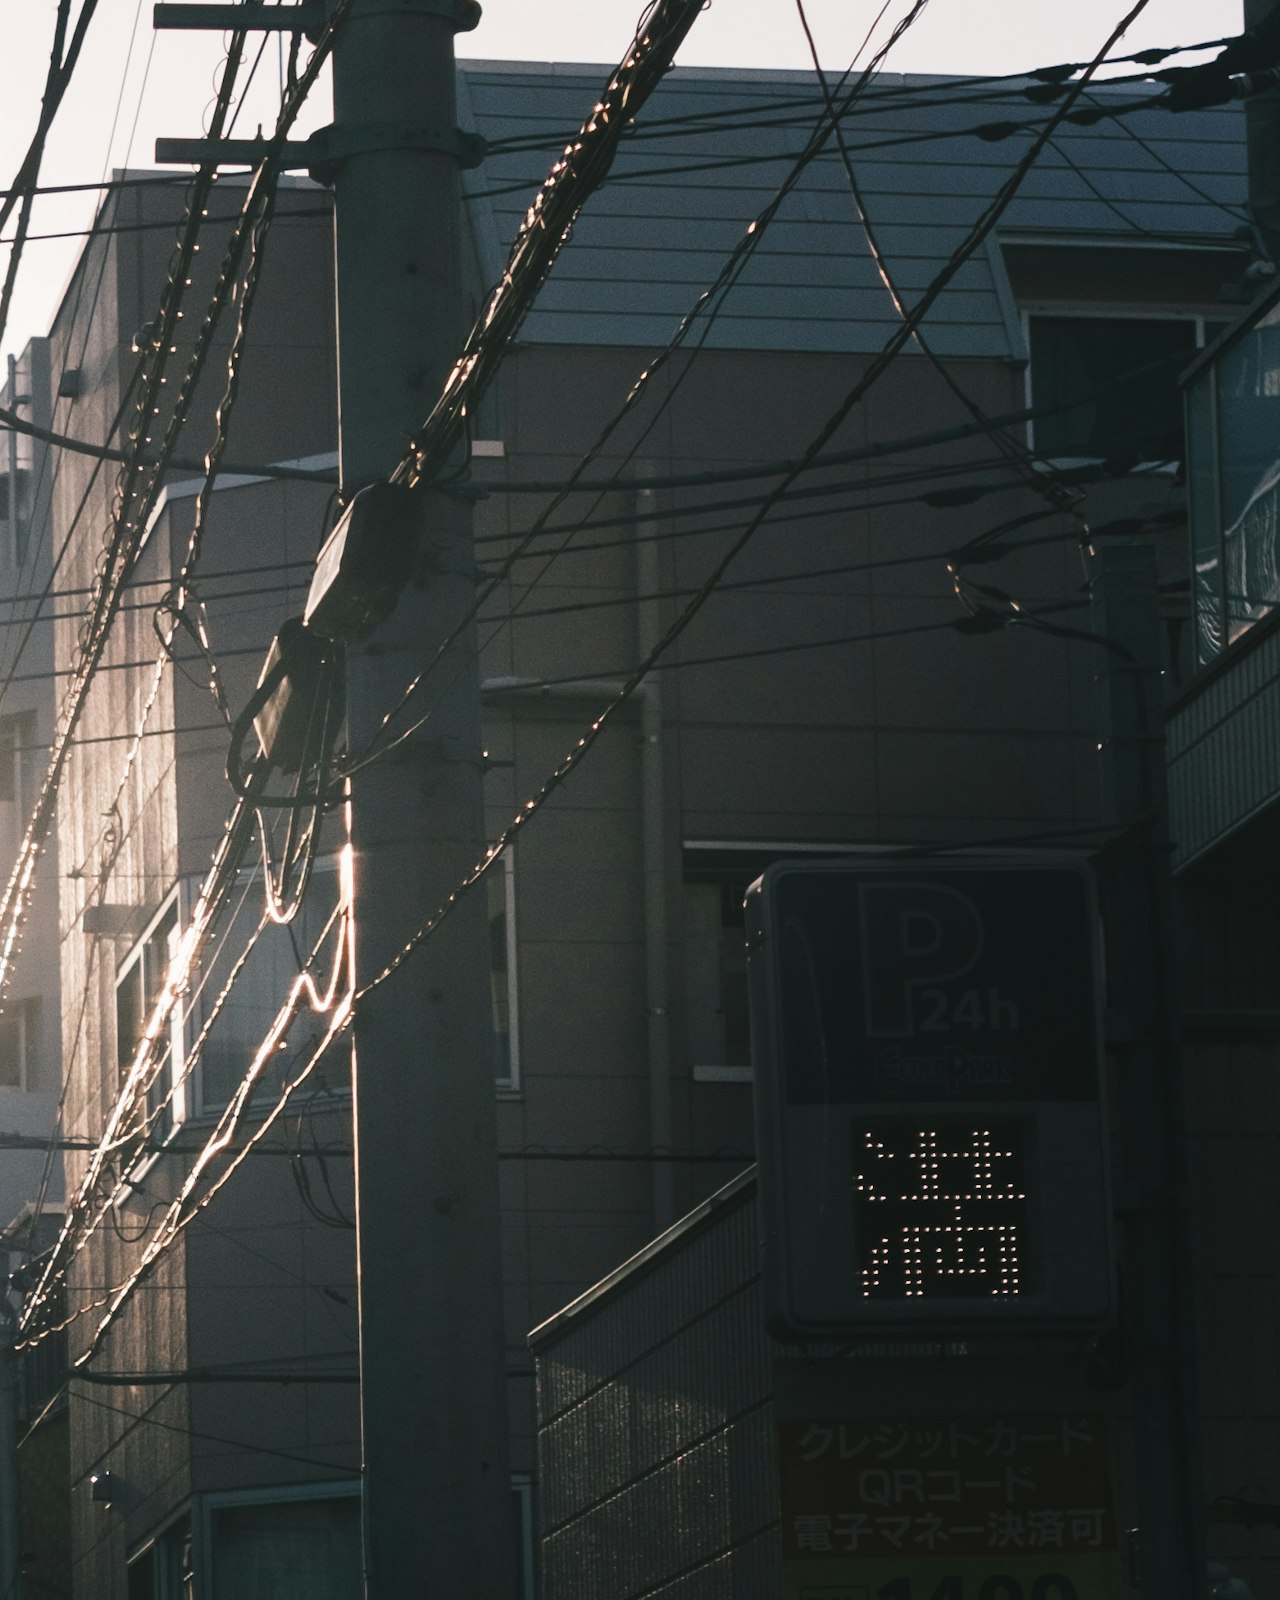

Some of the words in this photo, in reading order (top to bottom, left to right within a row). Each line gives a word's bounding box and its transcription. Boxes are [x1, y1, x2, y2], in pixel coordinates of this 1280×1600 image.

[856, 880, 985, 1038] P
[920, 987, 1020, 1032] 24h
[853, 1131, 1026, 1298] 満
[798, 1418, 1094, 1463] クレジットカード
[858, 1464, 1038, 1507] QRコード
[793, 1507, 1106, 1552] 電子マネー決済可
